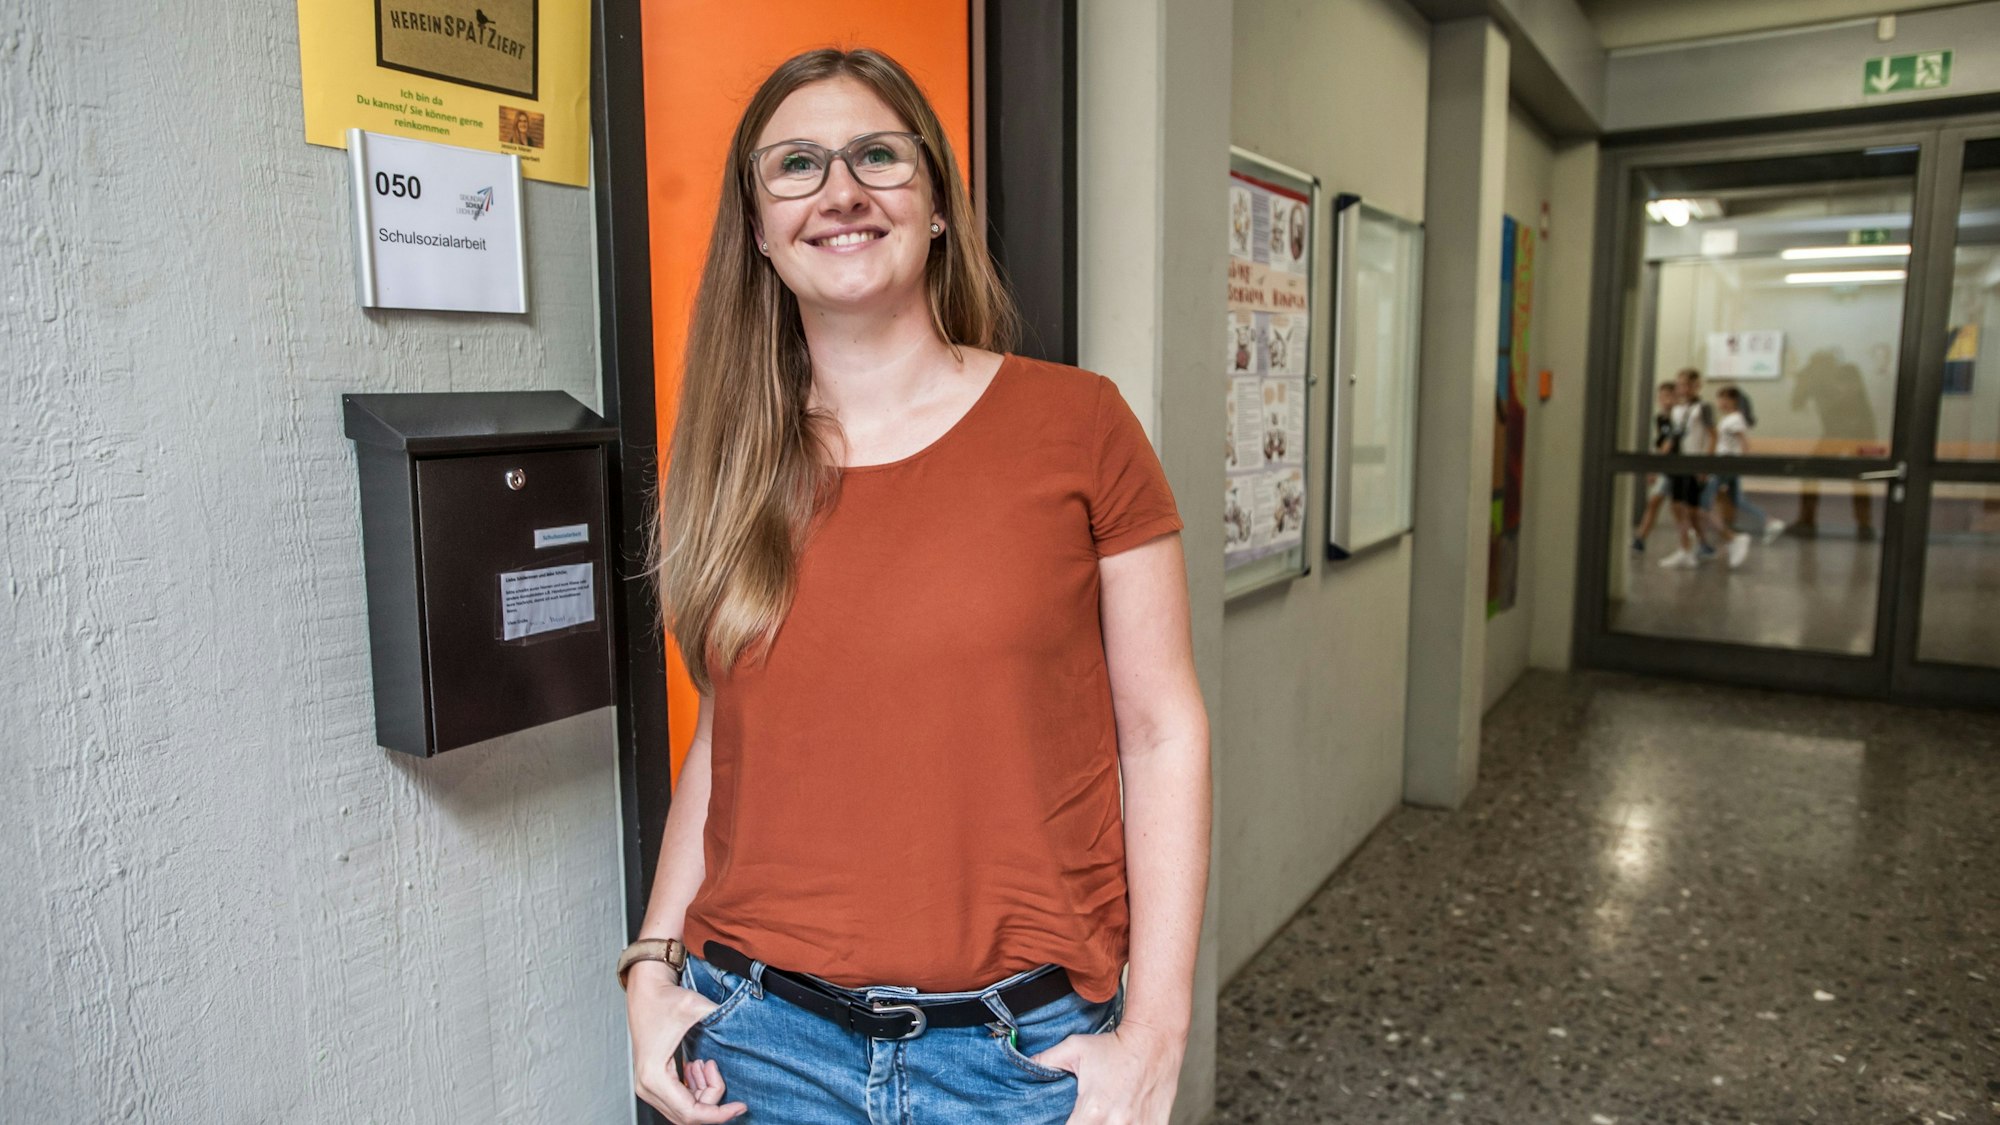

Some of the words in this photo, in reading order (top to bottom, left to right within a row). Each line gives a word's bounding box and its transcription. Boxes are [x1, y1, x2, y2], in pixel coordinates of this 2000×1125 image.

[400, 89, 414, 100] Ich
[416, 90, 430, 103] bin
[432, 96, 444, 106] da
[356, 94, 370, 105] Du
[410, 105, 423, 116] Sie
[425, 108, 457, 123] können
[459, 117, 484, 128] gerne
[394, 118, 450, 135] reinkommen
[375, 171, 422, 200] 050
[378, 228, 487, 251] Schulsozialarbeit
